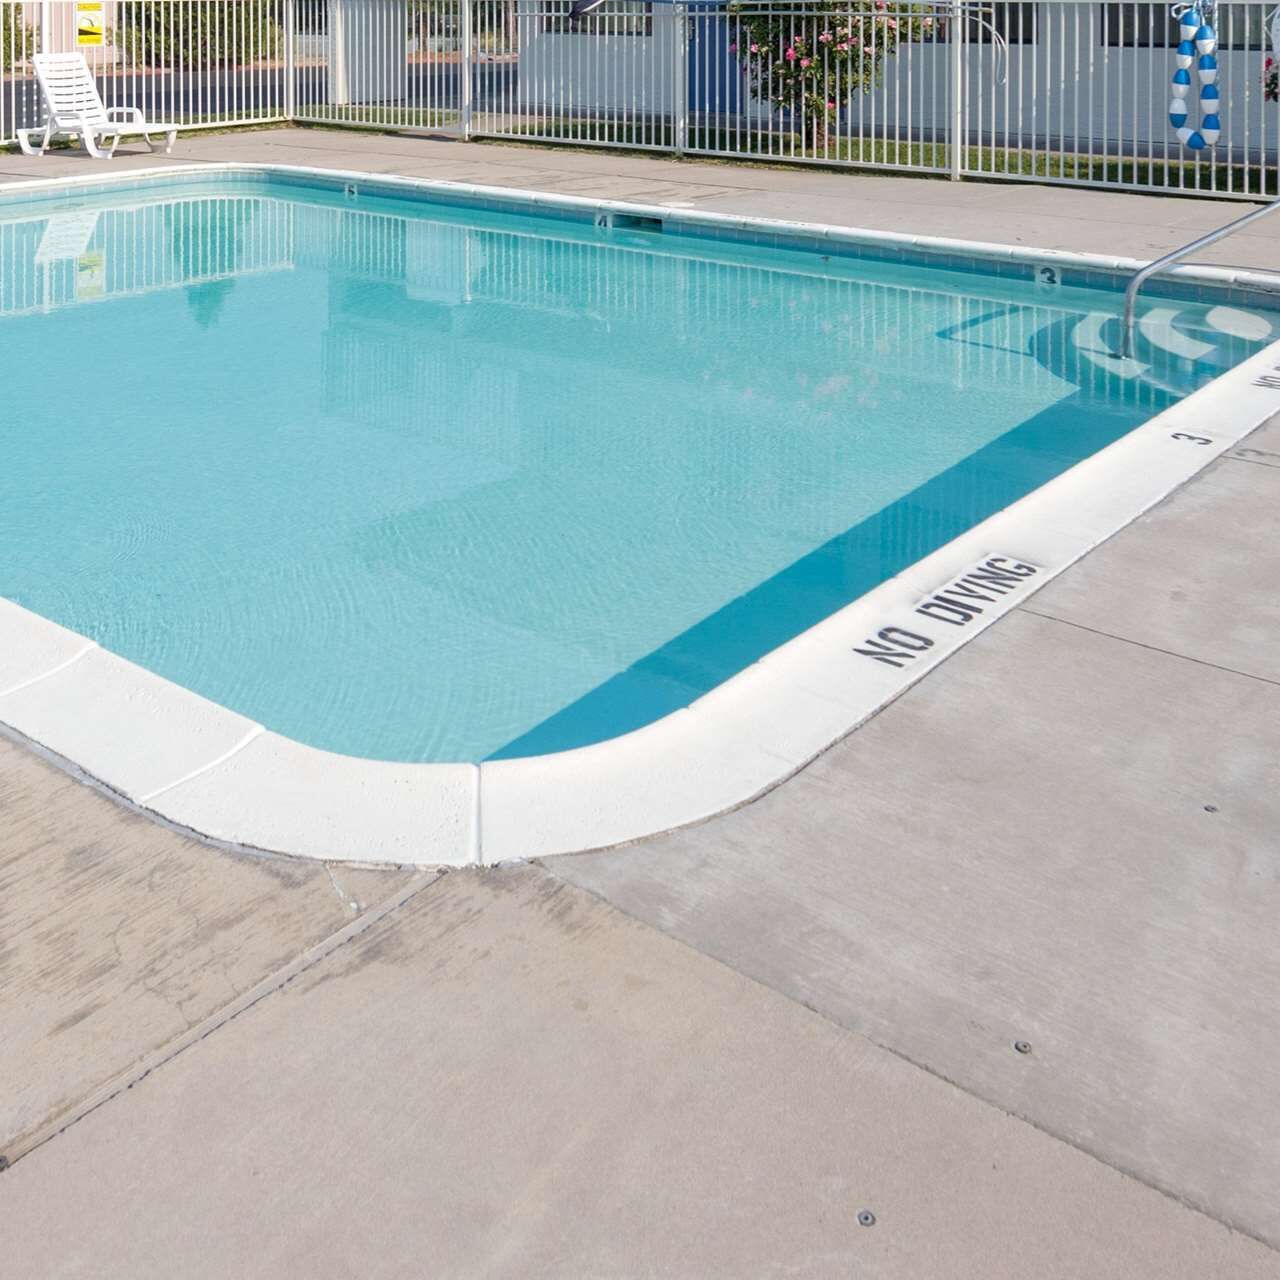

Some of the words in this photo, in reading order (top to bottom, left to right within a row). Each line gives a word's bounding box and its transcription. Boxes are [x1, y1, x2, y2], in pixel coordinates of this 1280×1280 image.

[1171, 431, 1214, 446] 3
[852, 625, 935, 668] NO
[914, 557, 1037, 627] DIVING
